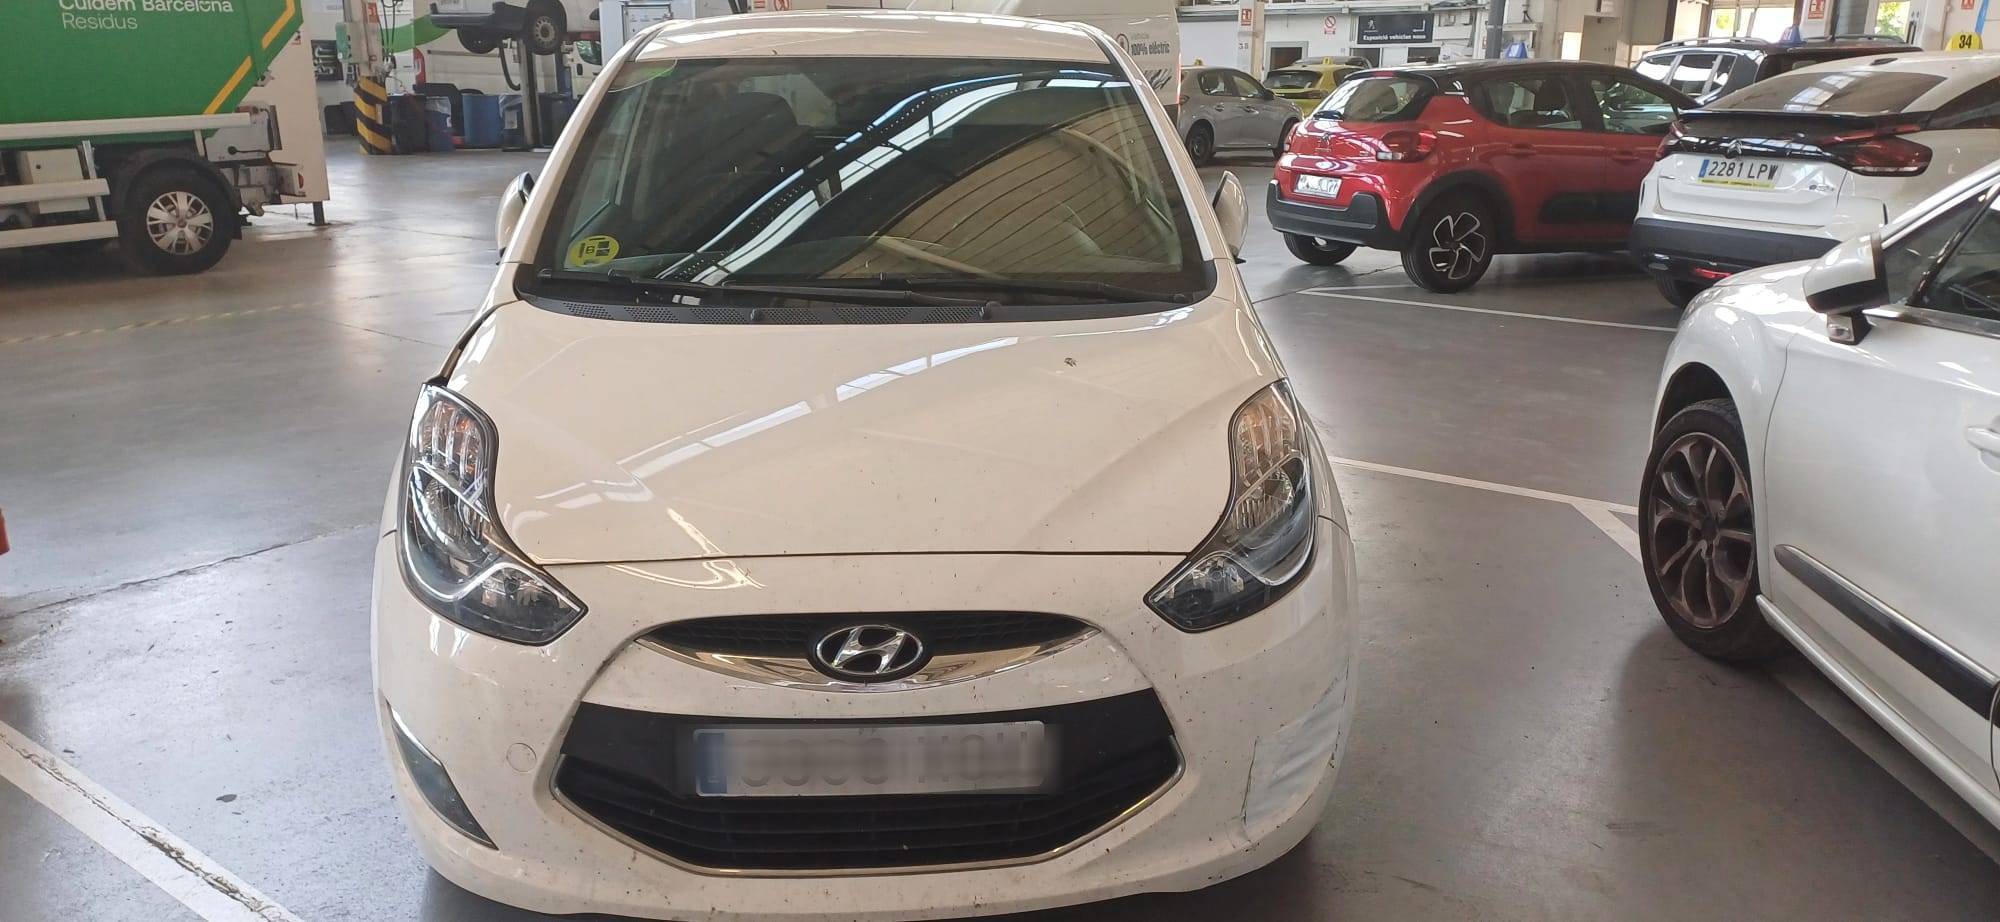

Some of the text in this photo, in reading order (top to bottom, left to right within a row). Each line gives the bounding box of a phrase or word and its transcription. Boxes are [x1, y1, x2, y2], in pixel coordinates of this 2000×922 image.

[143, 0, 234, 13] Barcelona
[62, 12, 138, 29] Residus
[1958, 34, 1972, 49] 34
[1131, 43, 1148, 56] 100%
[1708, 161, 1779, 181] 2281 LPW
